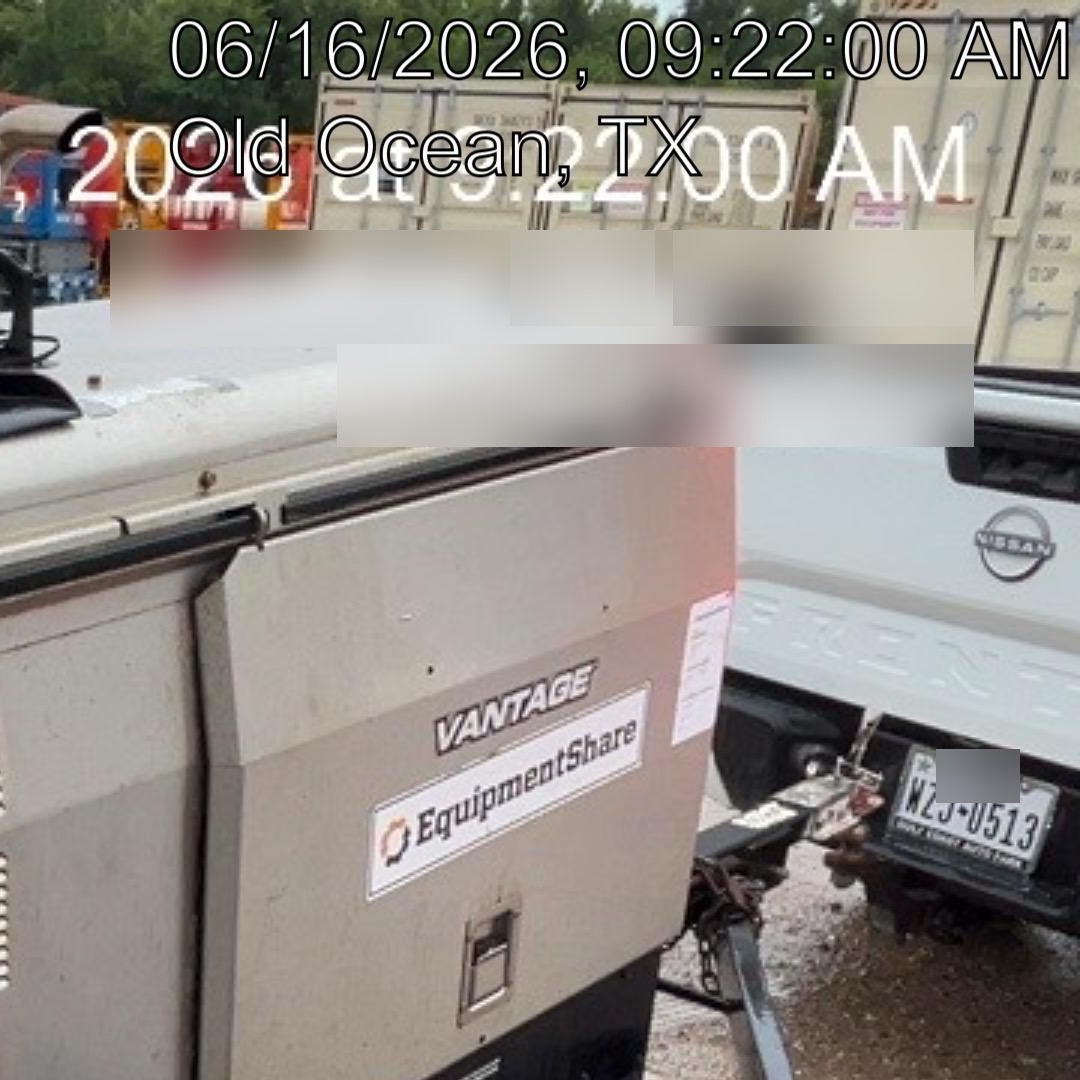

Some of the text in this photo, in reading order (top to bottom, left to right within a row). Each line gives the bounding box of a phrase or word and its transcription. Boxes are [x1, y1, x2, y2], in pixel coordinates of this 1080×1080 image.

[977, 532, 1051, 556] NISSAN
[434, 658, 599, 755] VANTAGE
[416, 718, 638, 844] EquipmentShare
